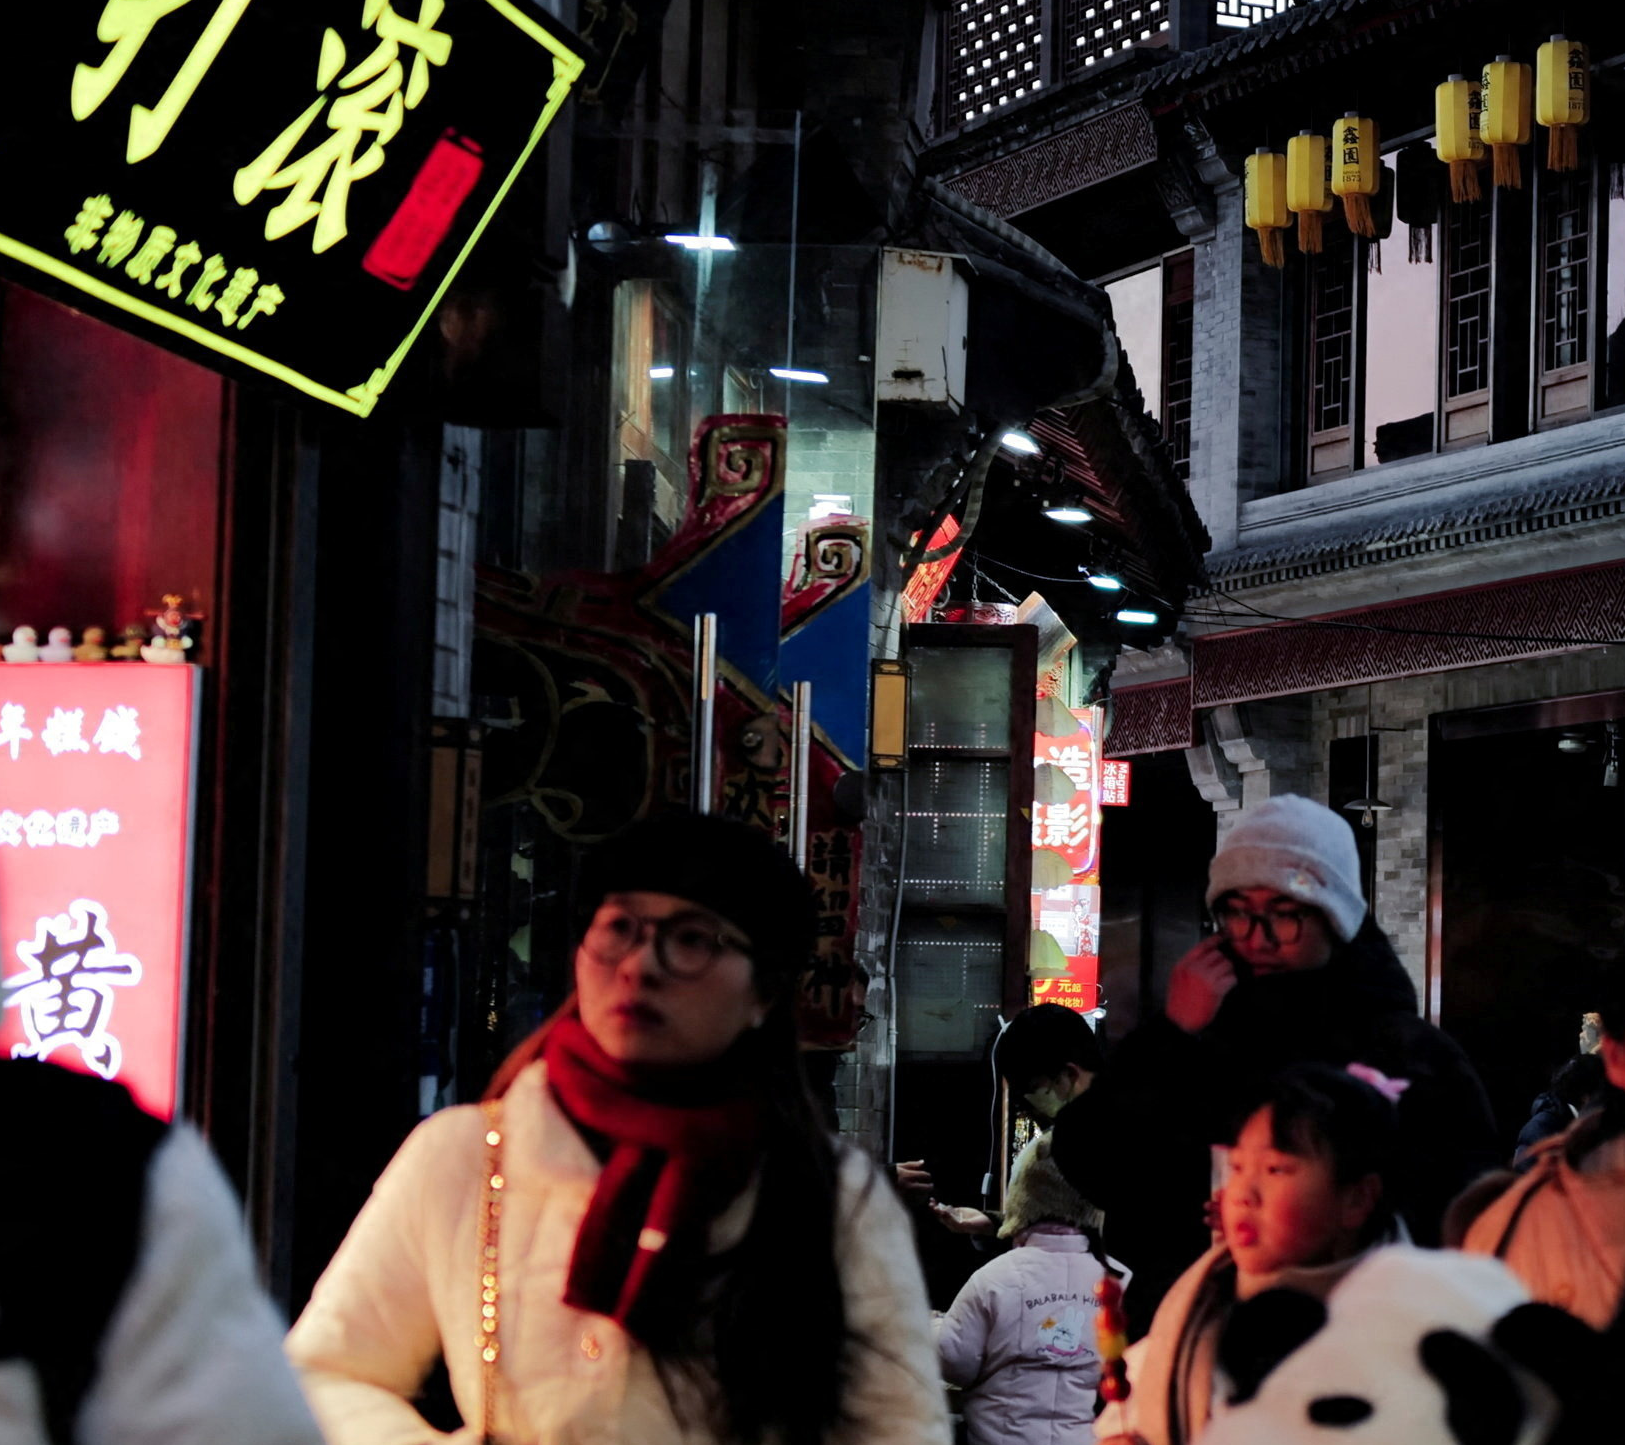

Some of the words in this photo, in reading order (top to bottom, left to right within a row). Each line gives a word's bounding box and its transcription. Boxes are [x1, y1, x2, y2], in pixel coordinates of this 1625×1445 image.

[1034, 745, 1092, 792] 造
[1103, 762, 1116, 804] 冰箱贴
[1116, 763, 1127, 804] Magnet
[1025, 1293, 1078, 1310] BALABALA
